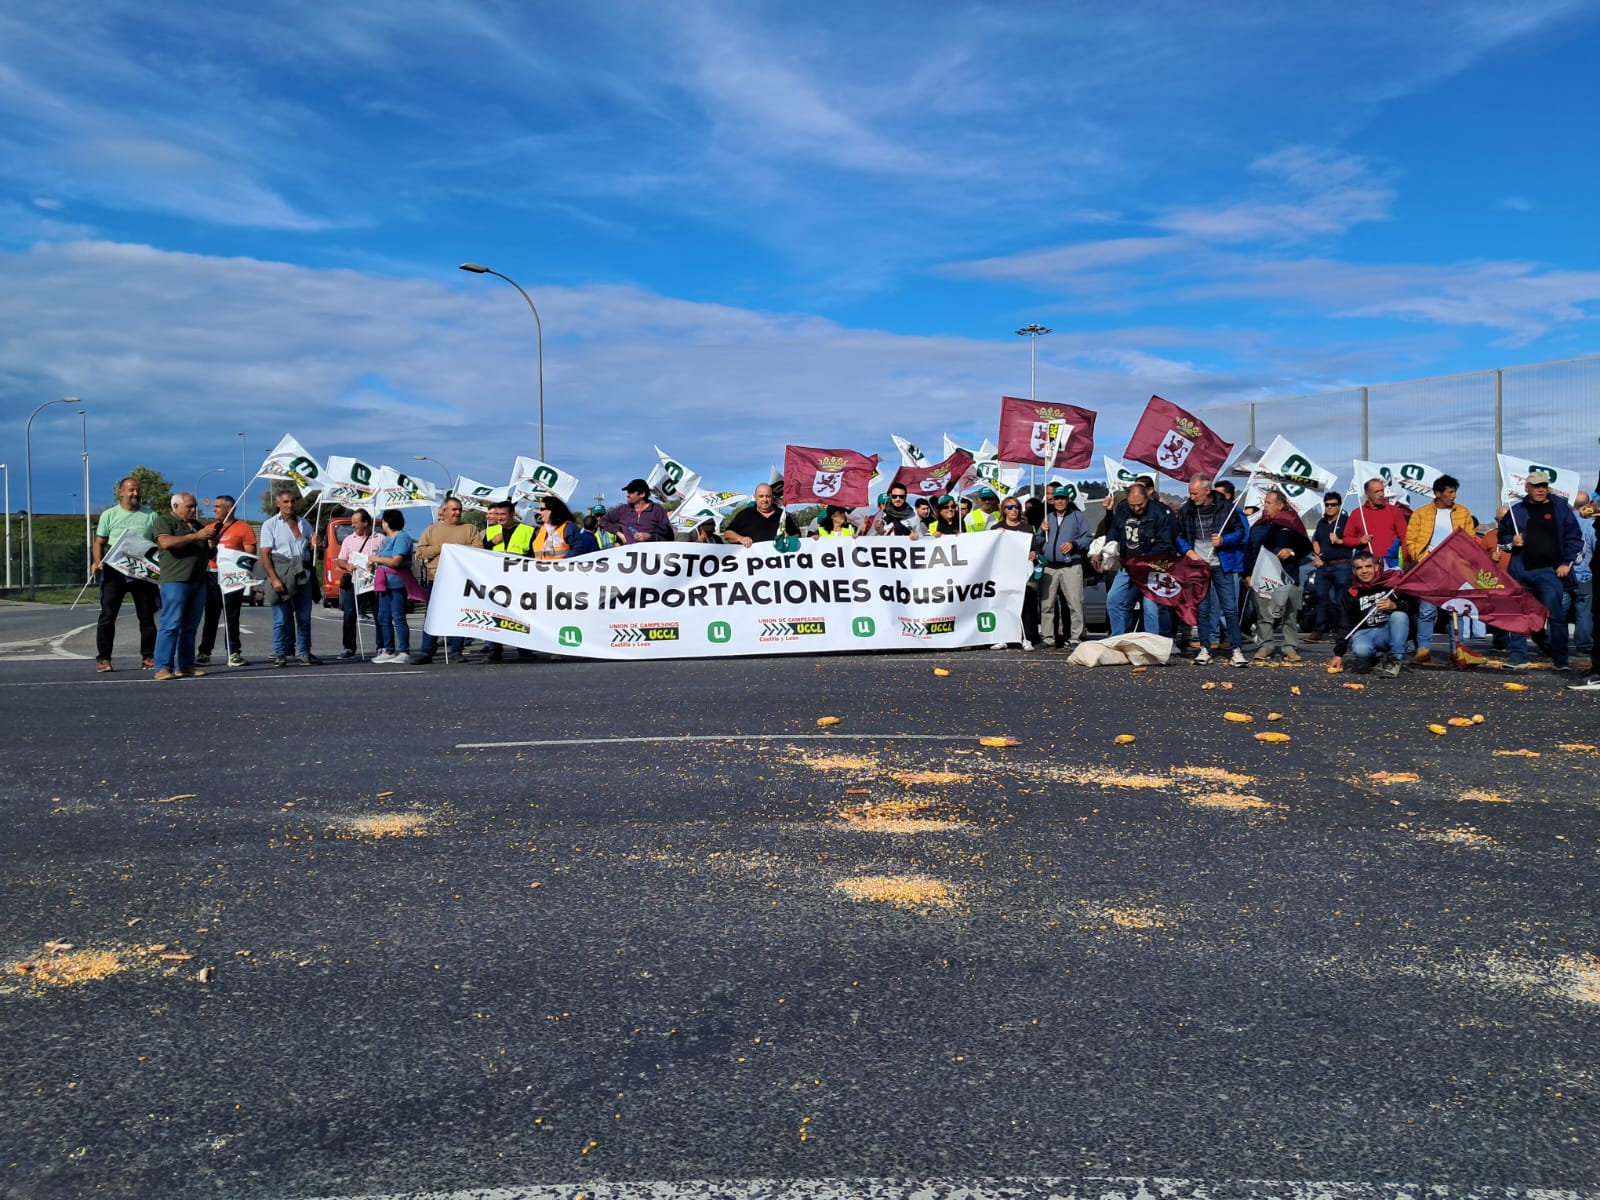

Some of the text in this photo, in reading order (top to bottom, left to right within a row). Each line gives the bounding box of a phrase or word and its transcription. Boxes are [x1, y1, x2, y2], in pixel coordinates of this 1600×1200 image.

[503, 545, 968, 577] Precios JUSTOS para el CEREAL
[463, 578, 996, 610] NO a las IMPORTACIONES abusivas
[500, 619, 528, 633] UCCL
[796, 623, 823, 634] UCCL
[930, 623, 952, 633] UCCL
[649, 629, 676, 640] UCCL
